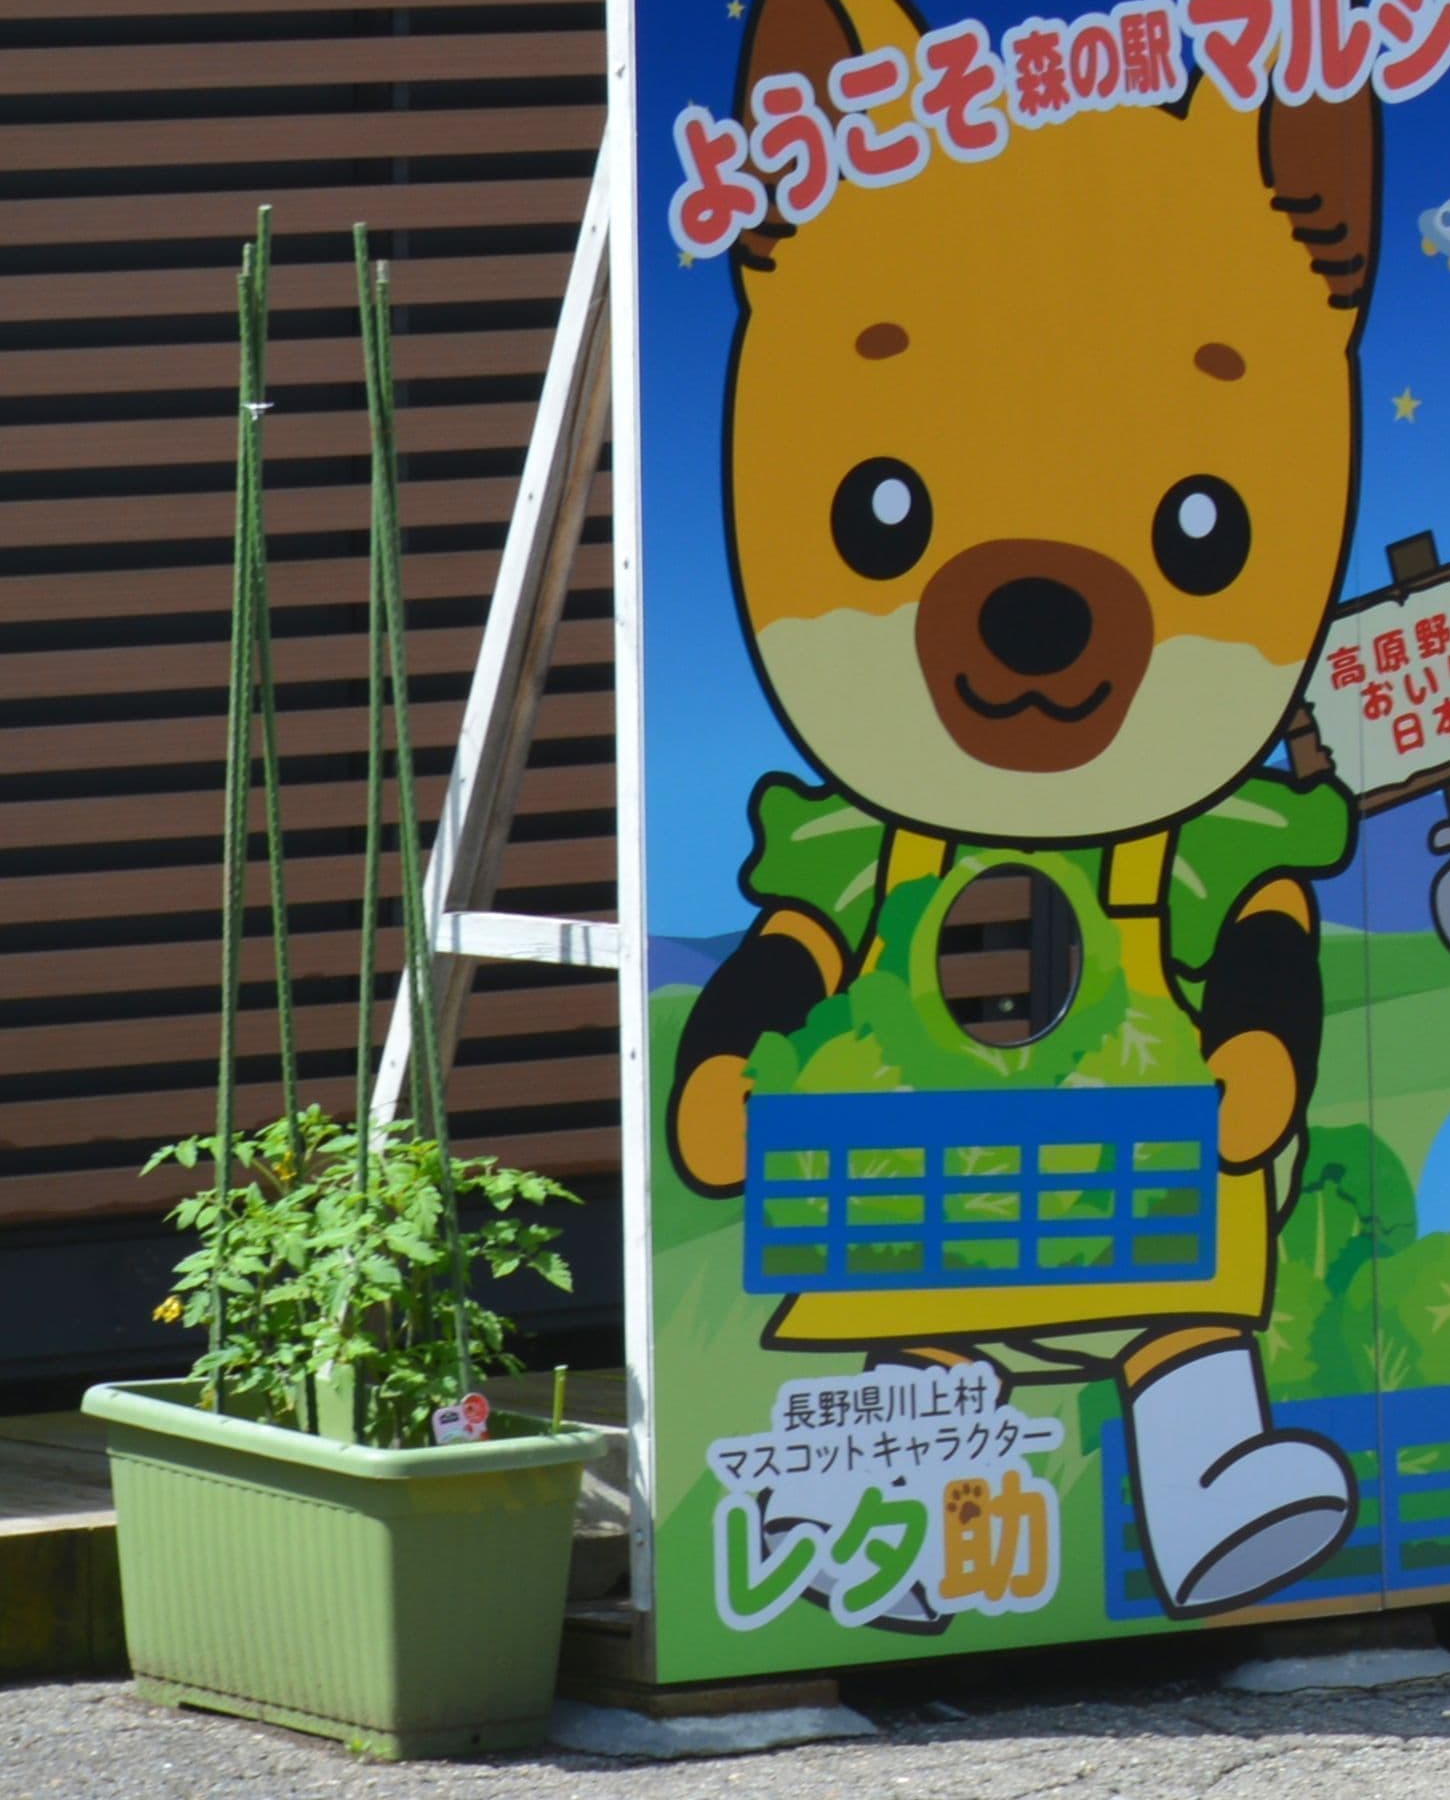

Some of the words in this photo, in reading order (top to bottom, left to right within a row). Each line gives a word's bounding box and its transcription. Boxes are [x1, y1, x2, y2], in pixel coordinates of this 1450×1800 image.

[783, 1376, 988, 1432] 長野県川上村
[718, 1422, 1055, 1479] マスコットキャラクター
[724, 1467, 1050, 1620] レタ助
